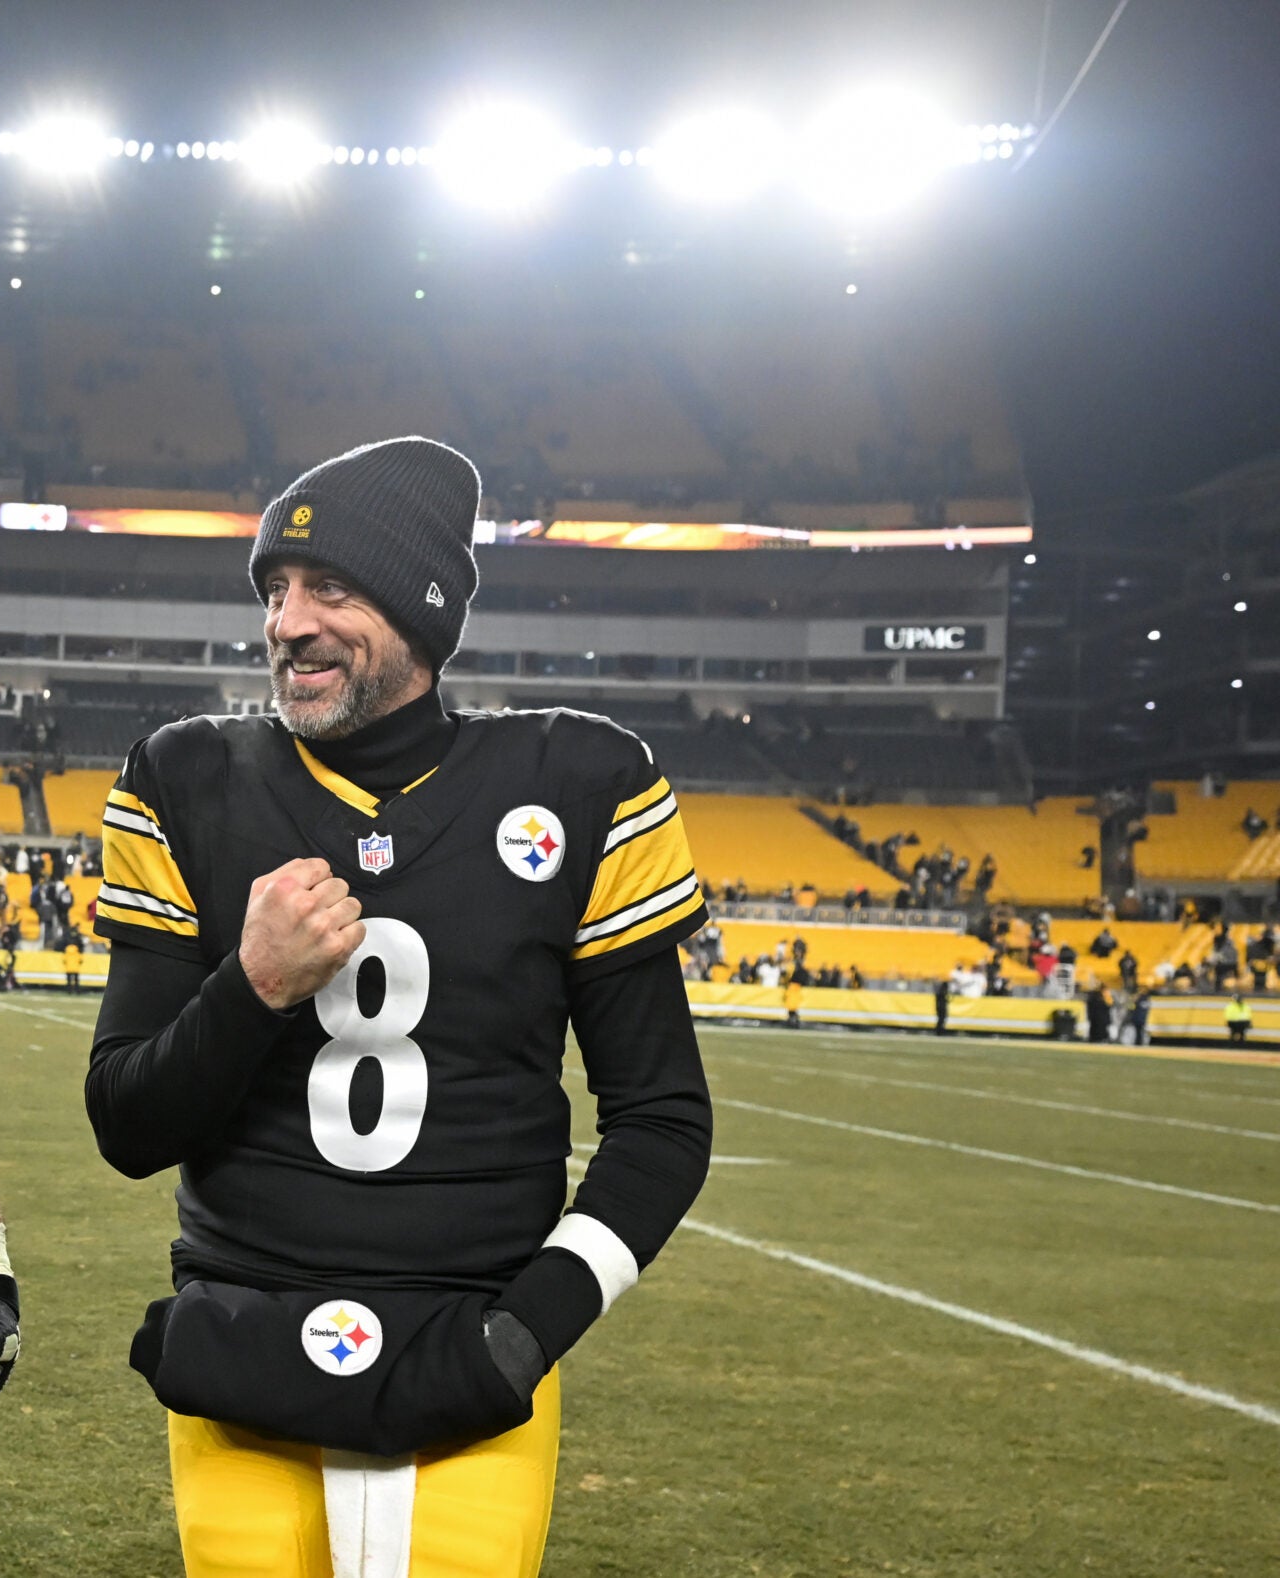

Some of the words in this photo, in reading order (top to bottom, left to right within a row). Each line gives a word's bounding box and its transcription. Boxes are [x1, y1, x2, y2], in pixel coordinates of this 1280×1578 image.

[883, 626, 966, 650] UPMC
[504, 835, 533, 847] Steelers
[364, 850, 389, 867] NFL
[307, 917, 430, 1172] 8
[309, 1327, 340, 1338] Steelers
